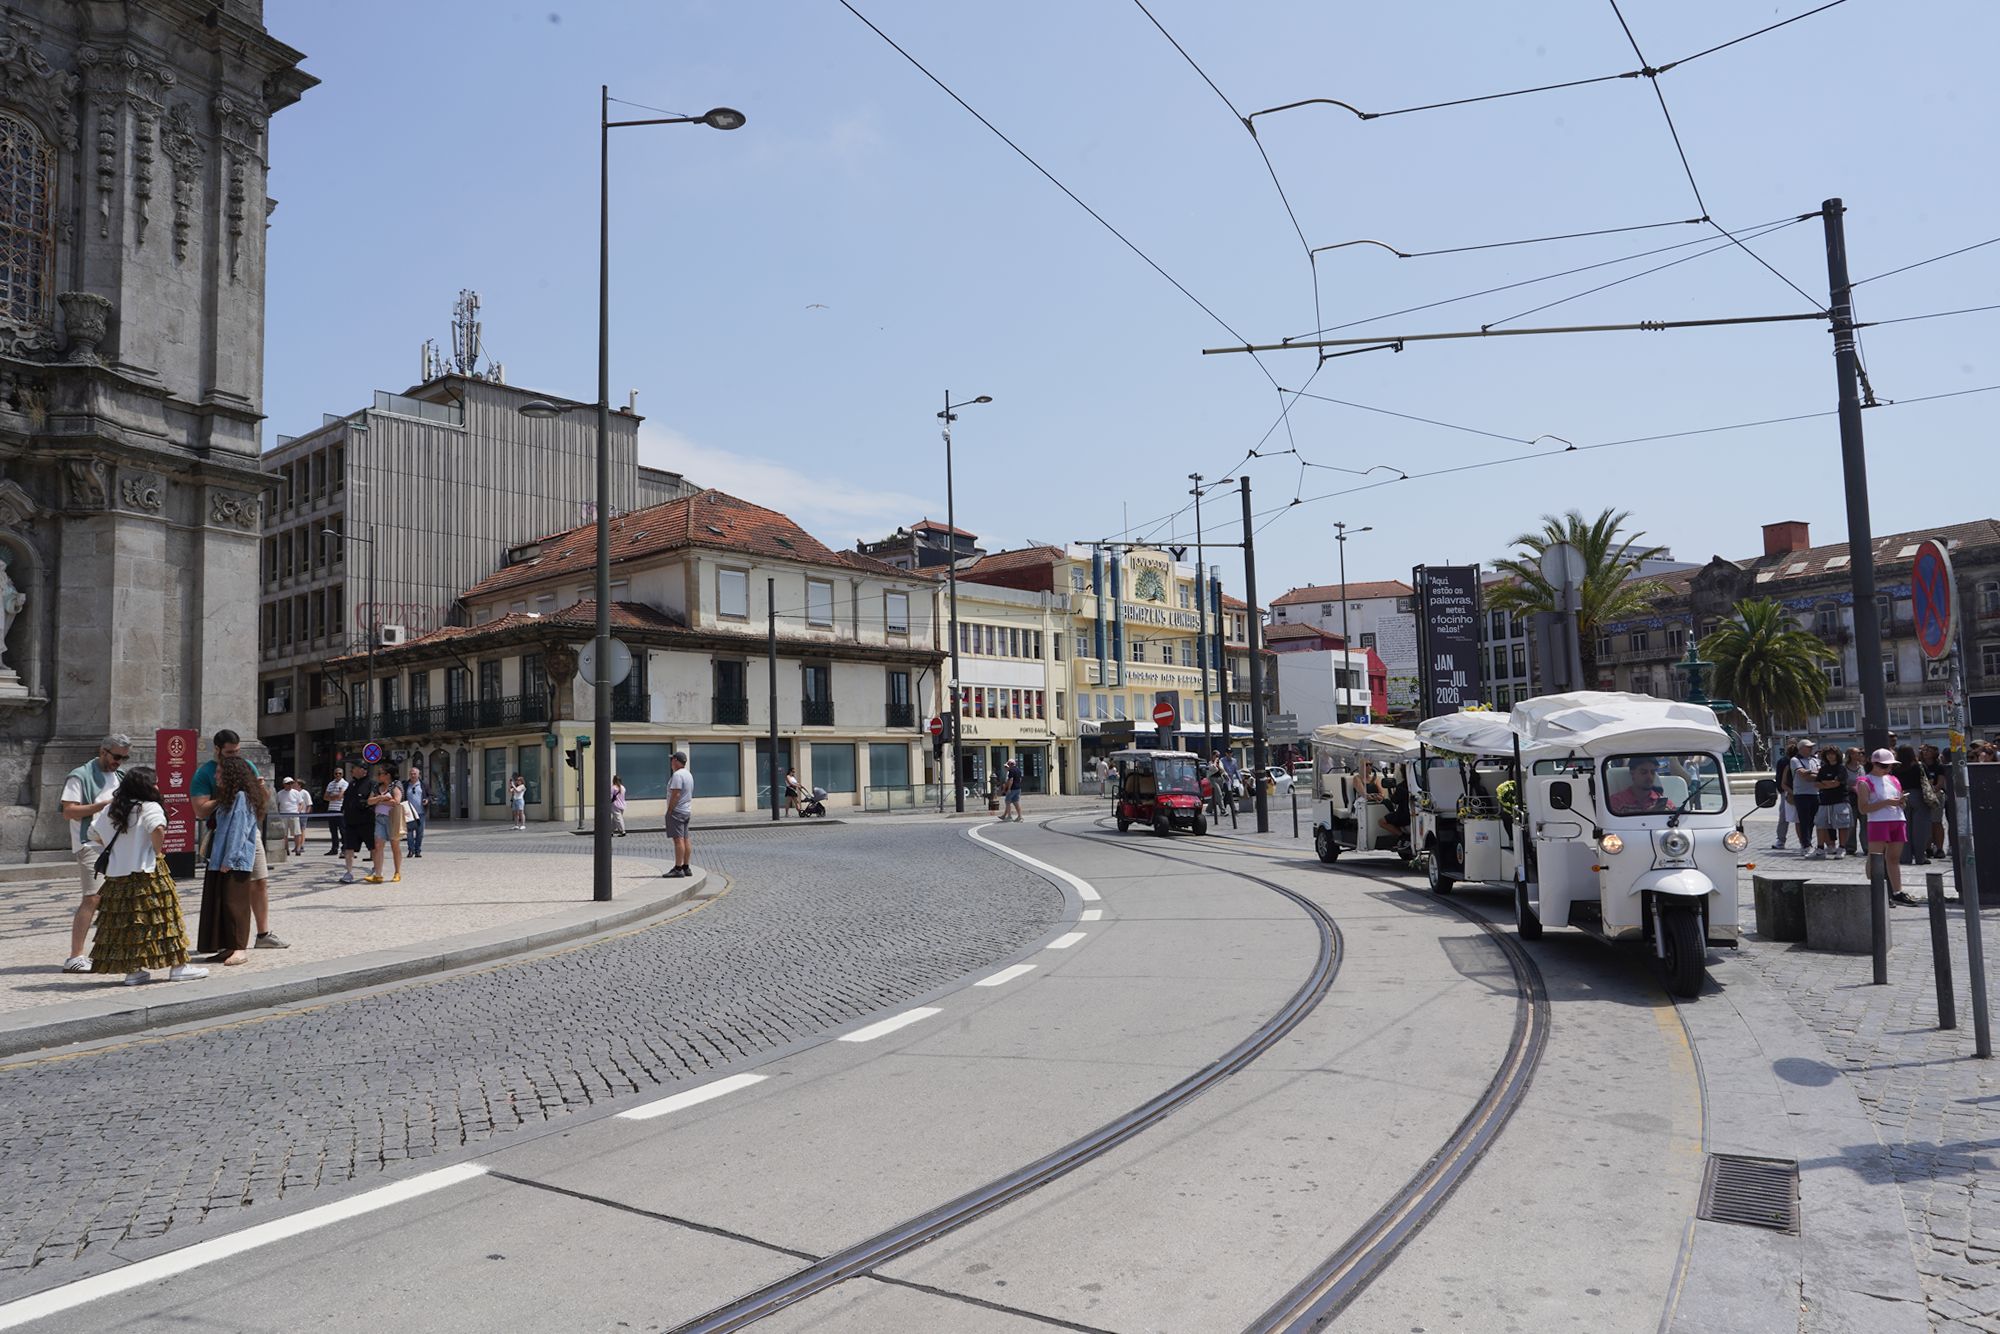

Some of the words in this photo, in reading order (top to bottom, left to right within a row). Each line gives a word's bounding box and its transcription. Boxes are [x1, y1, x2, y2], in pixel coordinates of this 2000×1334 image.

[1430, 596, 1474, 606] palavras,
[1437, 614, 1474, 624] focinho
[1434, 654, 1454, 671] JAN
[1436, 687, 1460, 704] 2026
[961, 724, 978, 734] ERA
